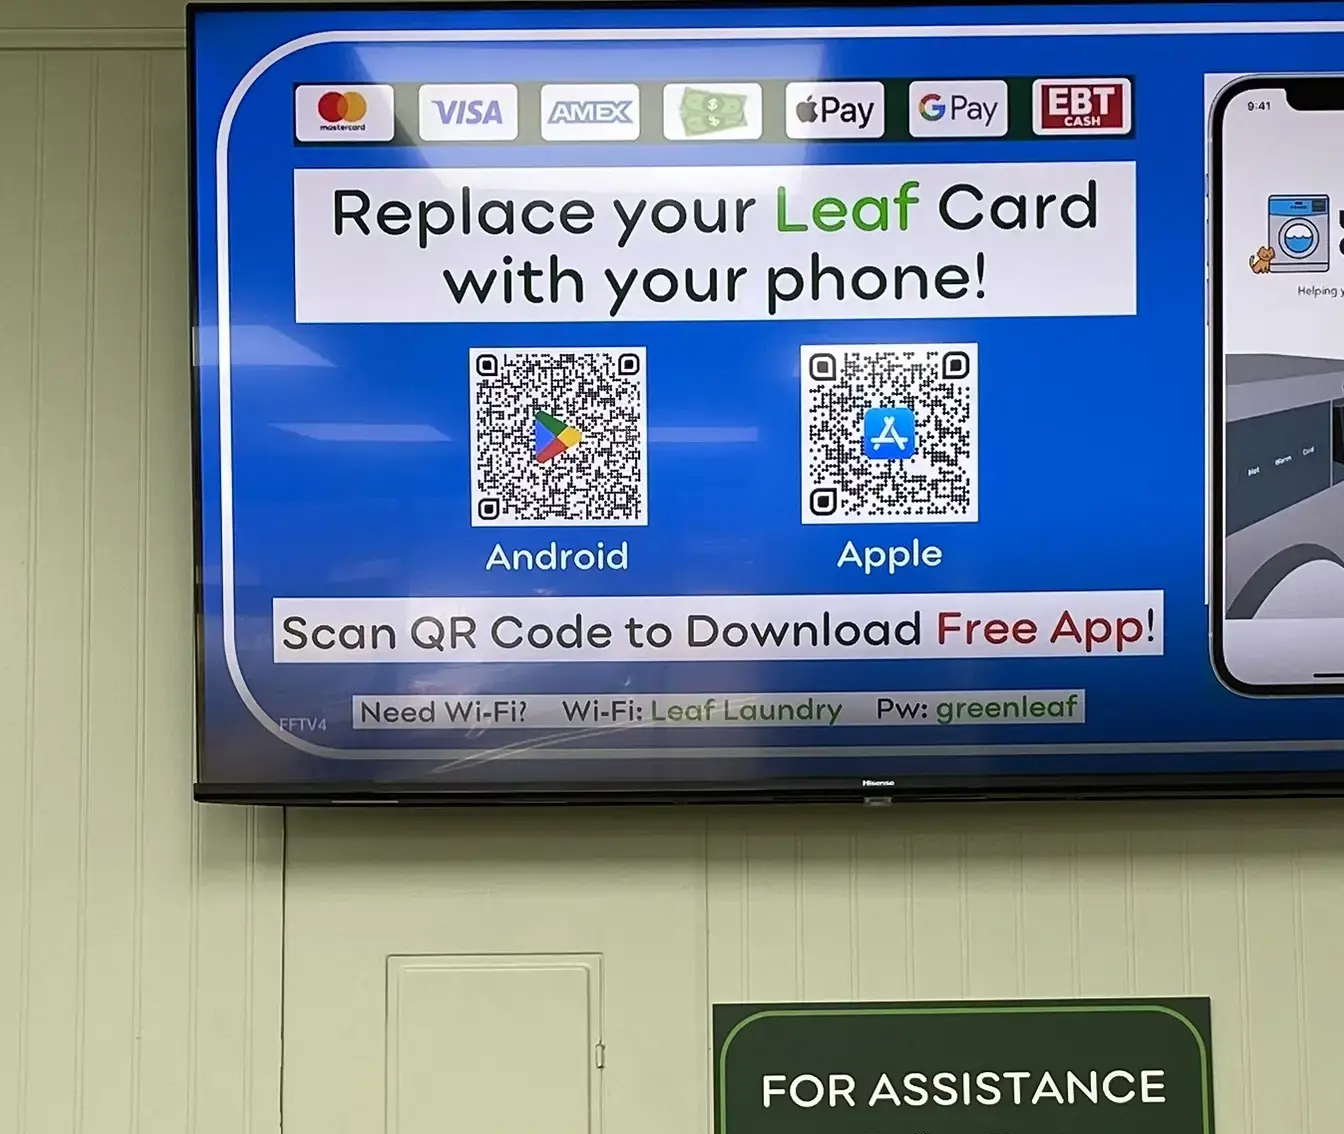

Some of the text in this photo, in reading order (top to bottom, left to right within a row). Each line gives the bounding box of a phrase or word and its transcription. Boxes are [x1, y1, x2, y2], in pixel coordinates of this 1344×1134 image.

[432, 100, 503, 124] VISA
[548, 101, 633, 124] AMEX
[821, 96, 874, 129] Pay
[951, 95, 998, 127] Pay
[1048, 87, 1115, 116] EBT
[1247, 101, 1271, 111] 9:41
[320, 123, 366, 131] mastercard
[1064, 116, 1101, 127] CASH
[334, 179, 1097, 248] Replace your Leaf Card
[443, 252, 985, 316] with your phone!
[1298, 286, 1337, 297] Helping
[486, 541, 628, 571] Android
[836, 537, 943, 574] Apple
[282, 608, 1155, 653] Scan QR Code to Download Free App!
[361, 700, 526, 723] Need Wi-Fi?
[562, 697, 843, 726] Wi-Fi: Leaf Laundry
[877, 694, 1078, 725] Pw: greenleaf
[862, 779, 895, 787] Hisense
[762, 1068, 1166, 1108] FOR ASSISTANCE
